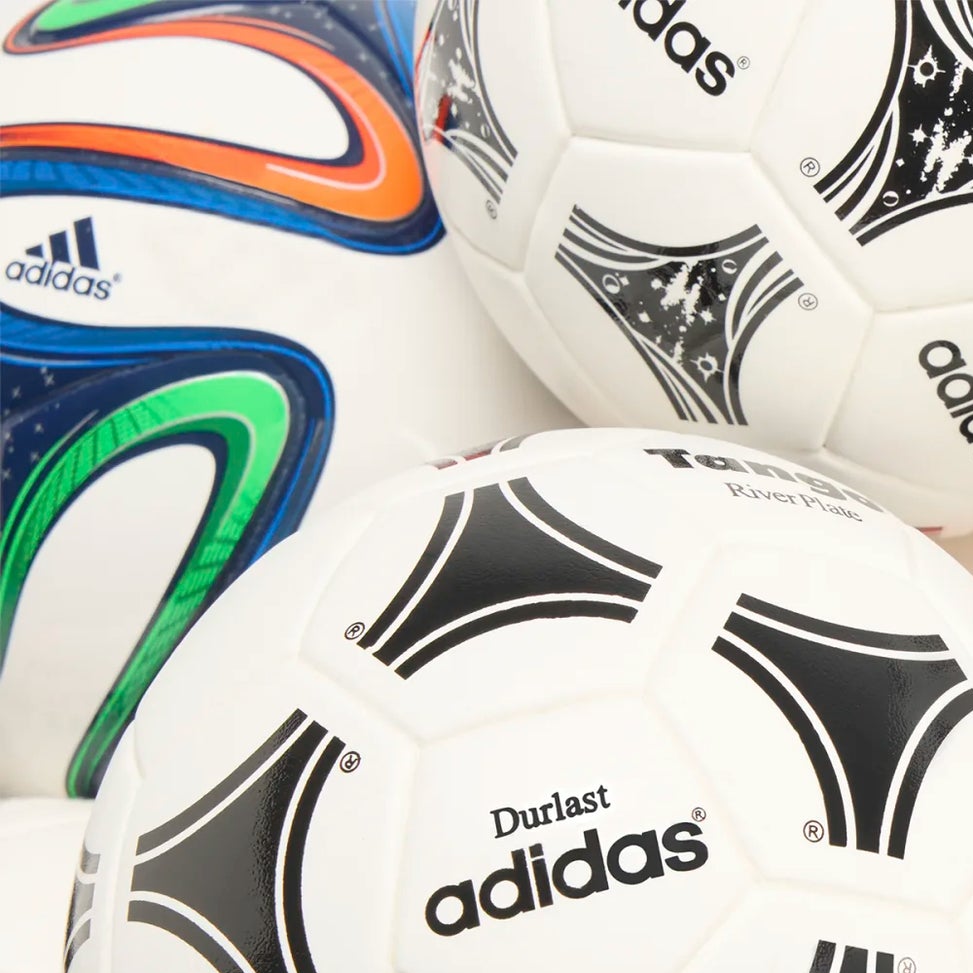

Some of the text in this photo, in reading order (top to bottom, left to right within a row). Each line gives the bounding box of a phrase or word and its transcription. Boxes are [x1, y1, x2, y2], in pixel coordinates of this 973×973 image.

[618, 0, 736, 97] das
[5, 261, 112, 300] adidas
[725, 482, 864, 522] River Plate
[490, 784, 612, 839] Durlast
[425, 821, 709, 937] adidas
